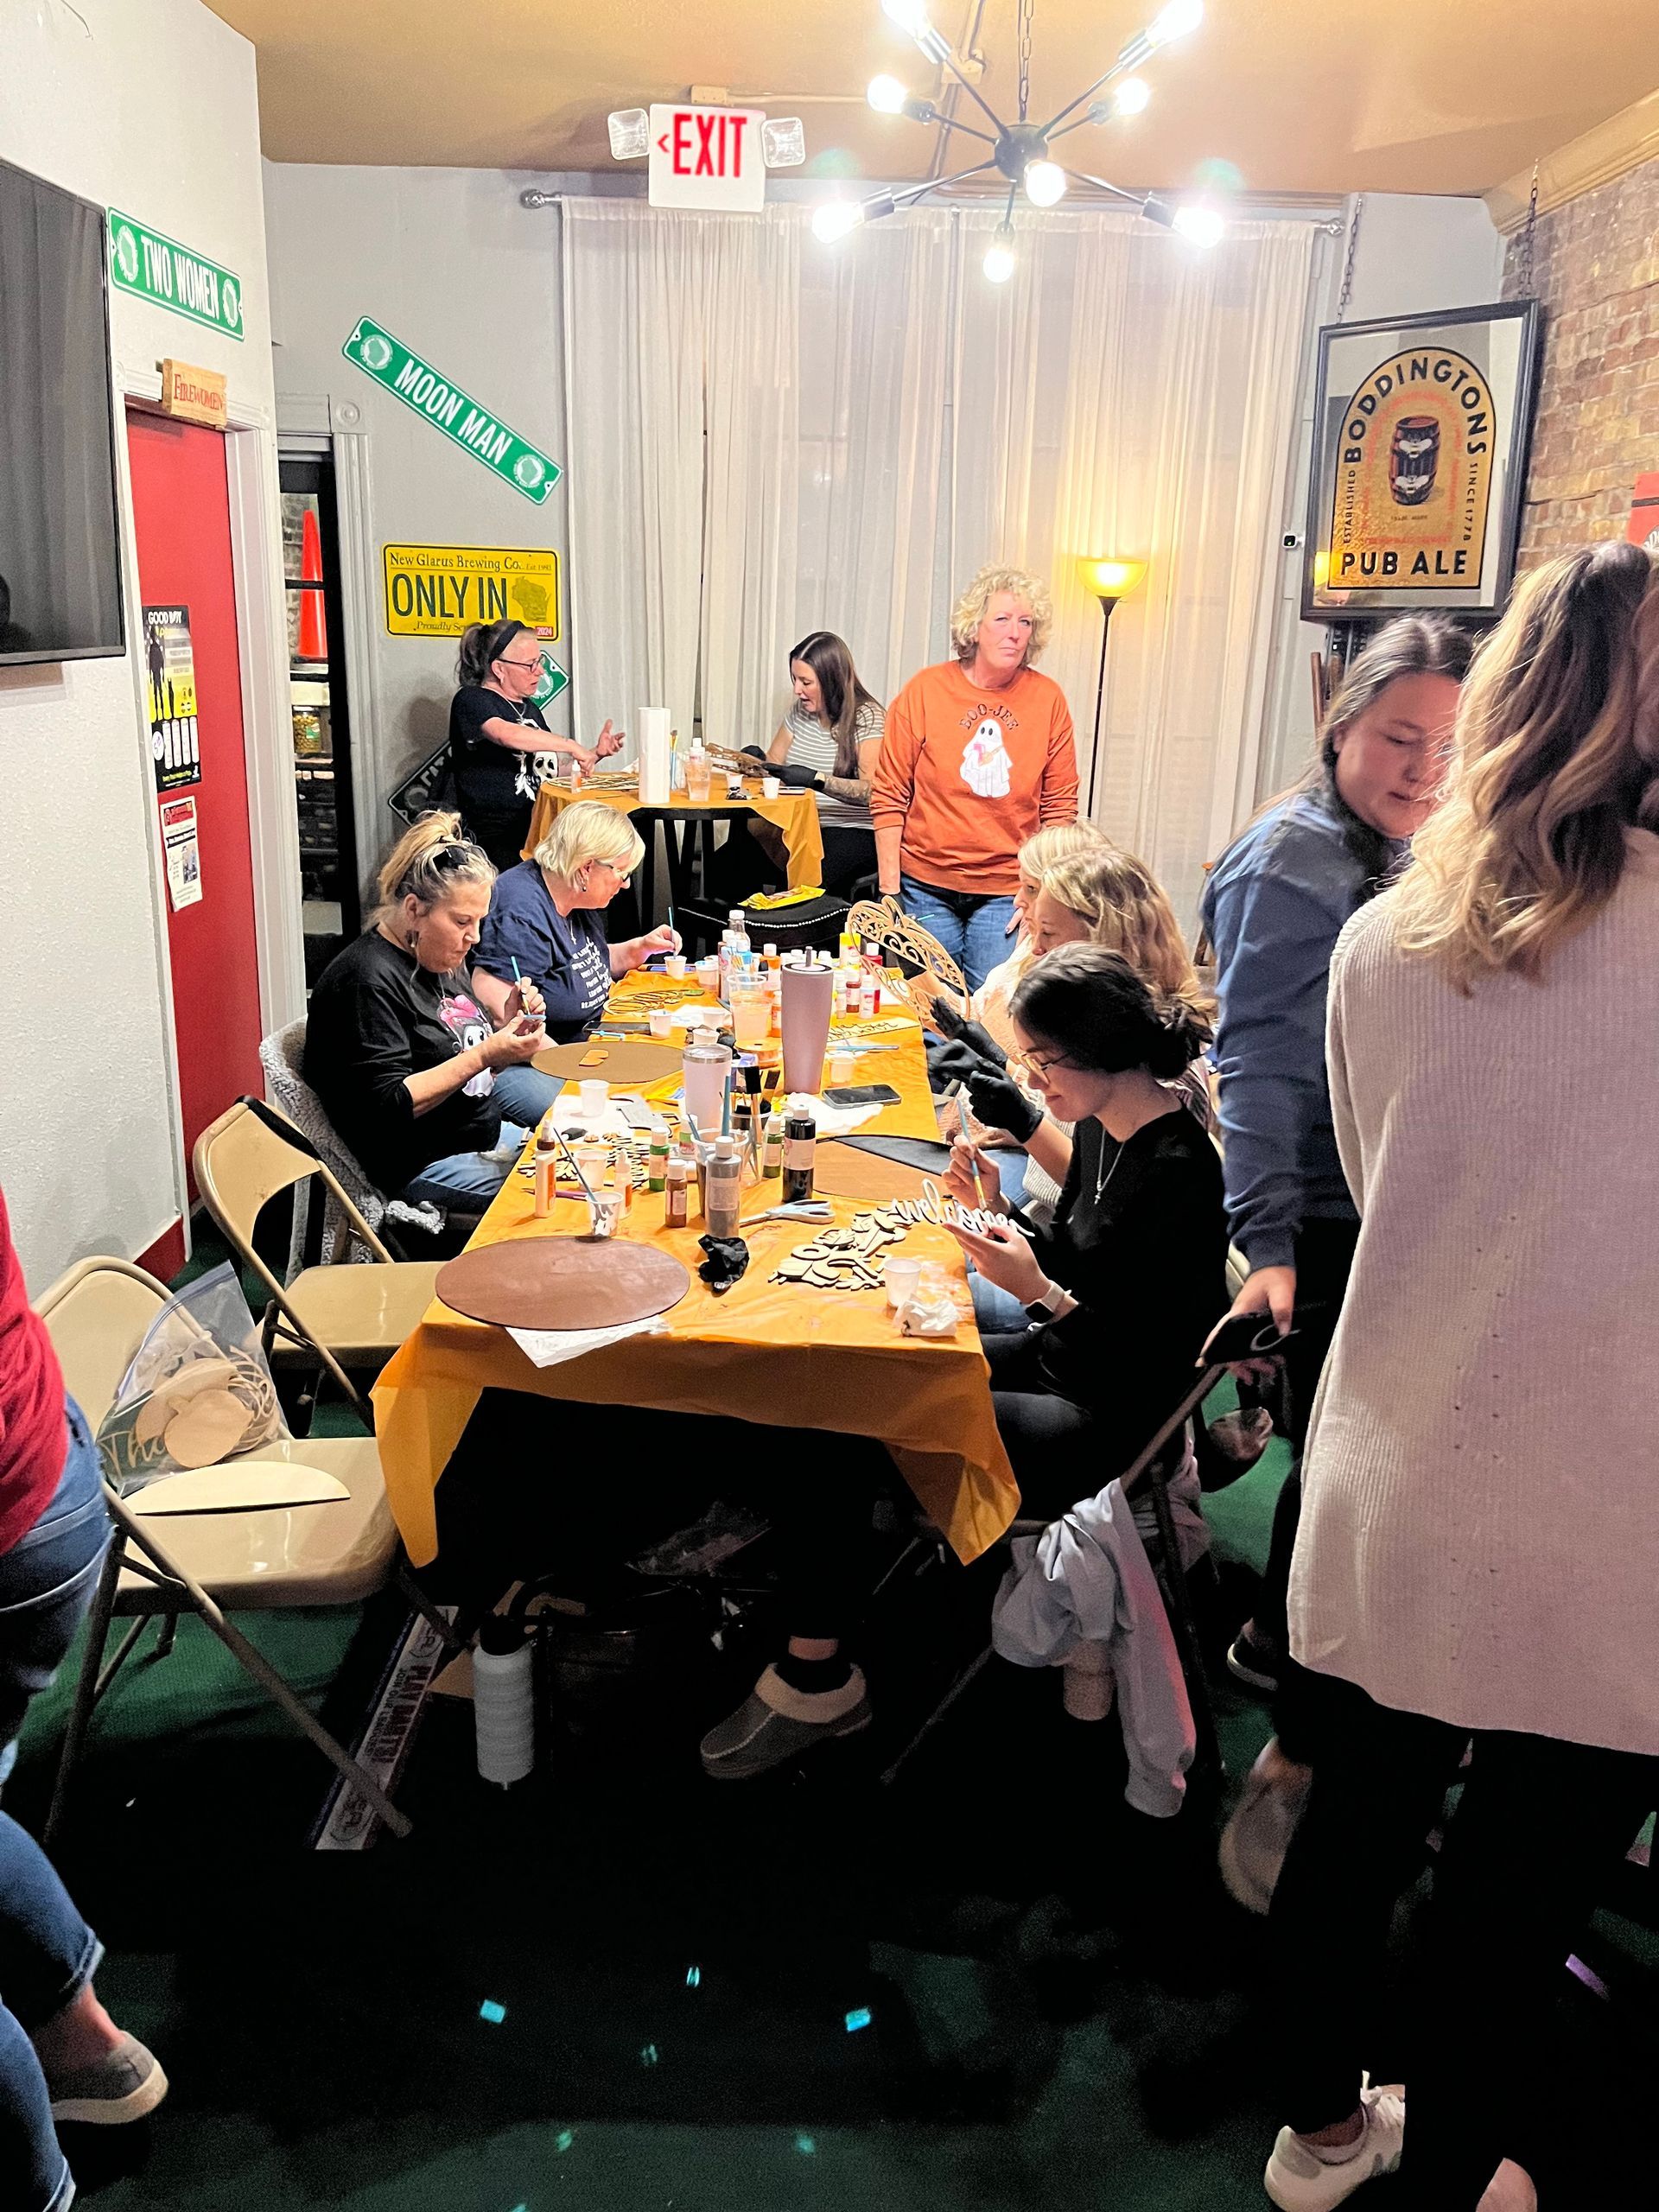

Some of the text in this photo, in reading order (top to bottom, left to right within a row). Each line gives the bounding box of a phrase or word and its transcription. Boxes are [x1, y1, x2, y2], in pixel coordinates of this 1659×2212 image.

[673, 112, 747, 178] EXIT
[140, 234, 219, 321] TWO WOMEN
[394, 358, 513, 465] MOON MAN
[1344, 357, 1488, 463] BODDINGTONS
[1466, 462, 1478, 504] SINCE
[1344, 469, 1356, 543] ESTABLISHED
[390, 552, 414, 566] New
[416, 554, 454, 568] Glarus
[456, 555, 500, 572] Brewing
[1341, 550, 1467, 575] PUB ALE
[391, 573, 507, 620] ONLY IN
[148, 611, 168, 625] GOOD
[416, 620, 451, 632] Proudly
[536, 626, 553, 636] 2024
[959, 703, 1019, 730] BOO-JEE
[393, 1667, 407, 1688] JOIN
[397, 1664, 433, 1701] PLAY
